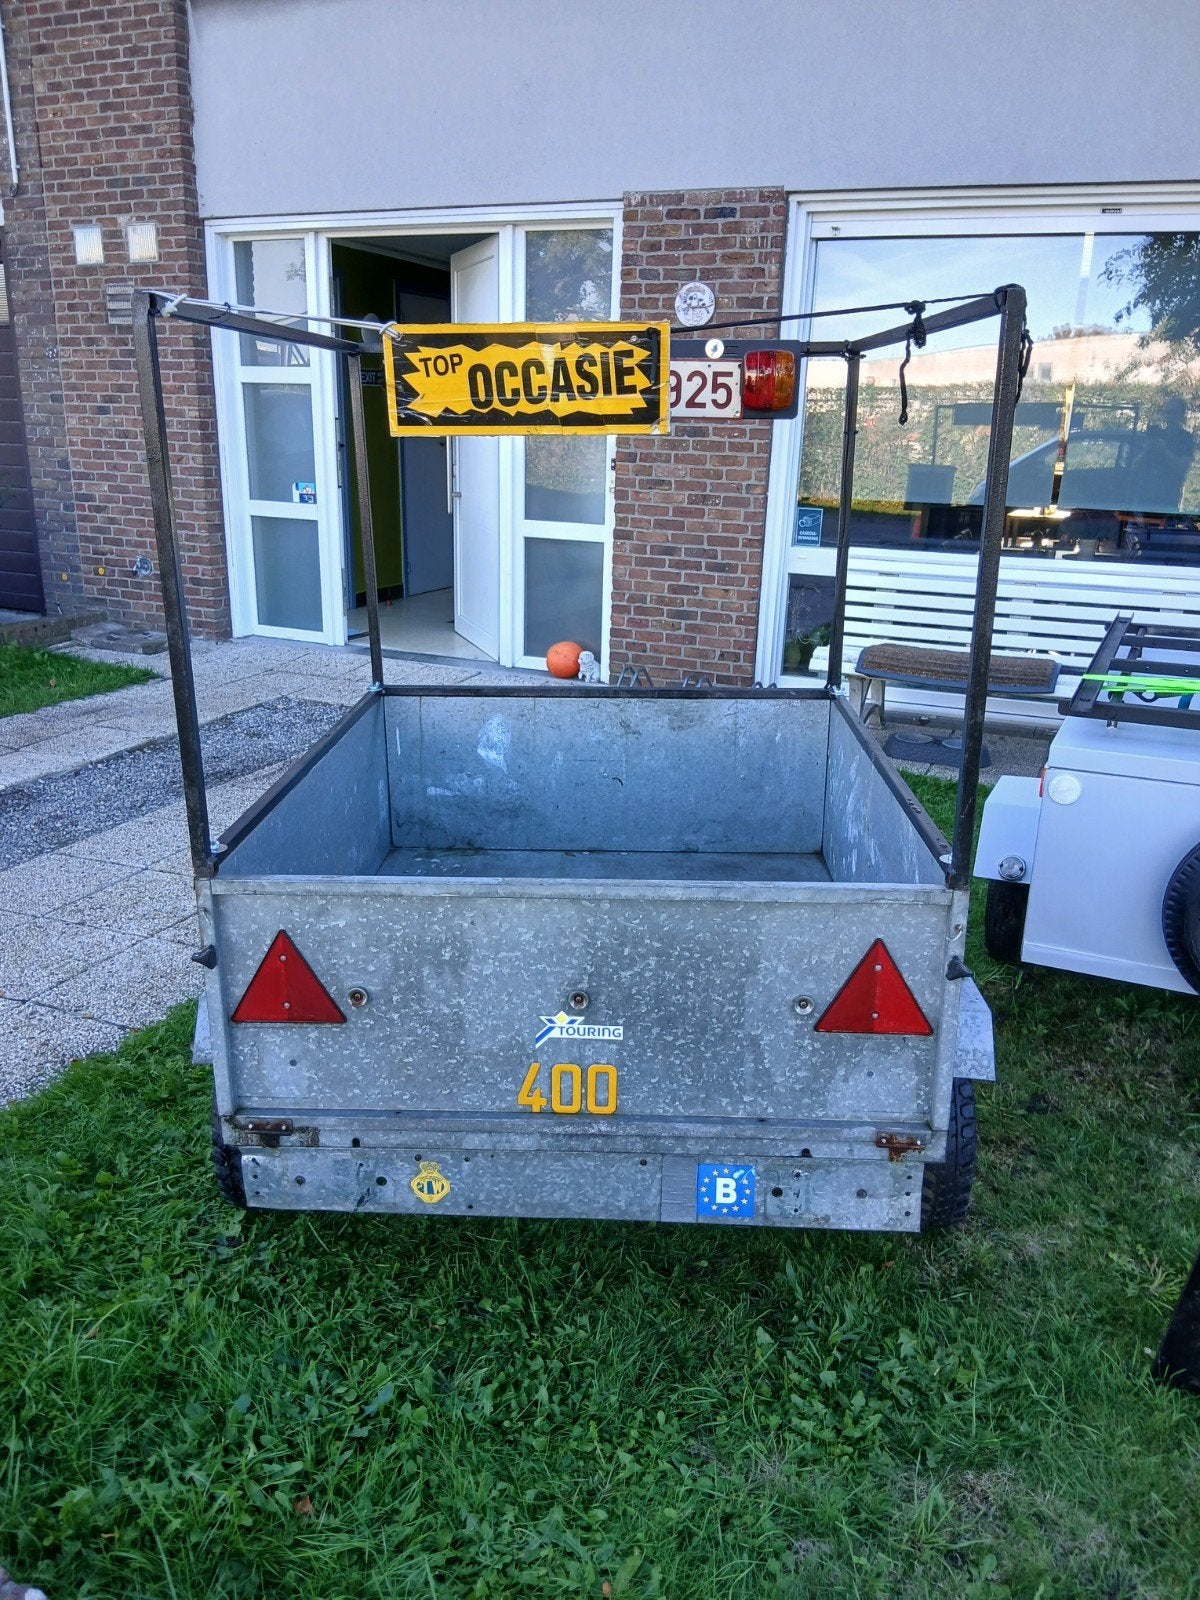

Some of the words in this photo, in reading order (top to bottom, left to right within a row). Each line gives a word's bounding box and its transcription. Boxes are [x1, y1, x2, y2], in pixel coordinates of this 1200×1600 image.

[419, 354, 463, 377] TOP
[468, 349, 637, 410] OCCASIE
[557, 1026, 622, 1038] TOURING
[517, 1062, 618, 1115] 400
[715, 1177, 737, 1204] B
